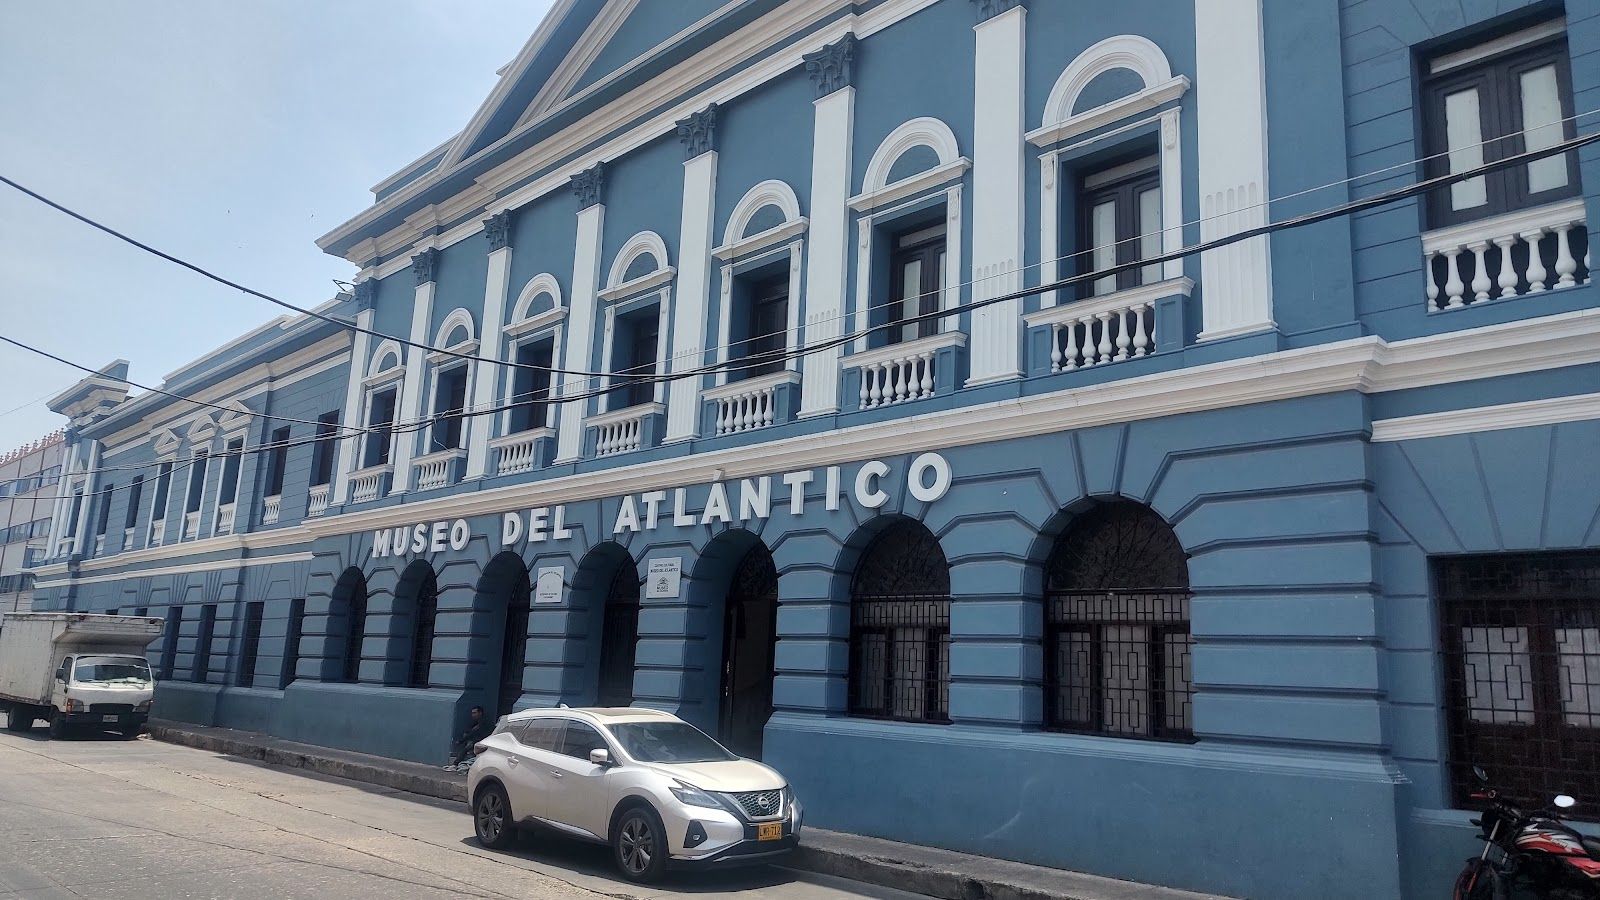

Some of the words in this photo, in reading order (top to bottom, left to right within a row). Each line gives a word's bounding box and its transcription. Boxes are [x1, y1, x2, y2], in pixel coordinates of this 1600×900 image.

[372, 518, 471, 558] MUSEO
[502, 505, 572, 545] DEL
[613, 452, 953, 534] ATLÁNTICO
